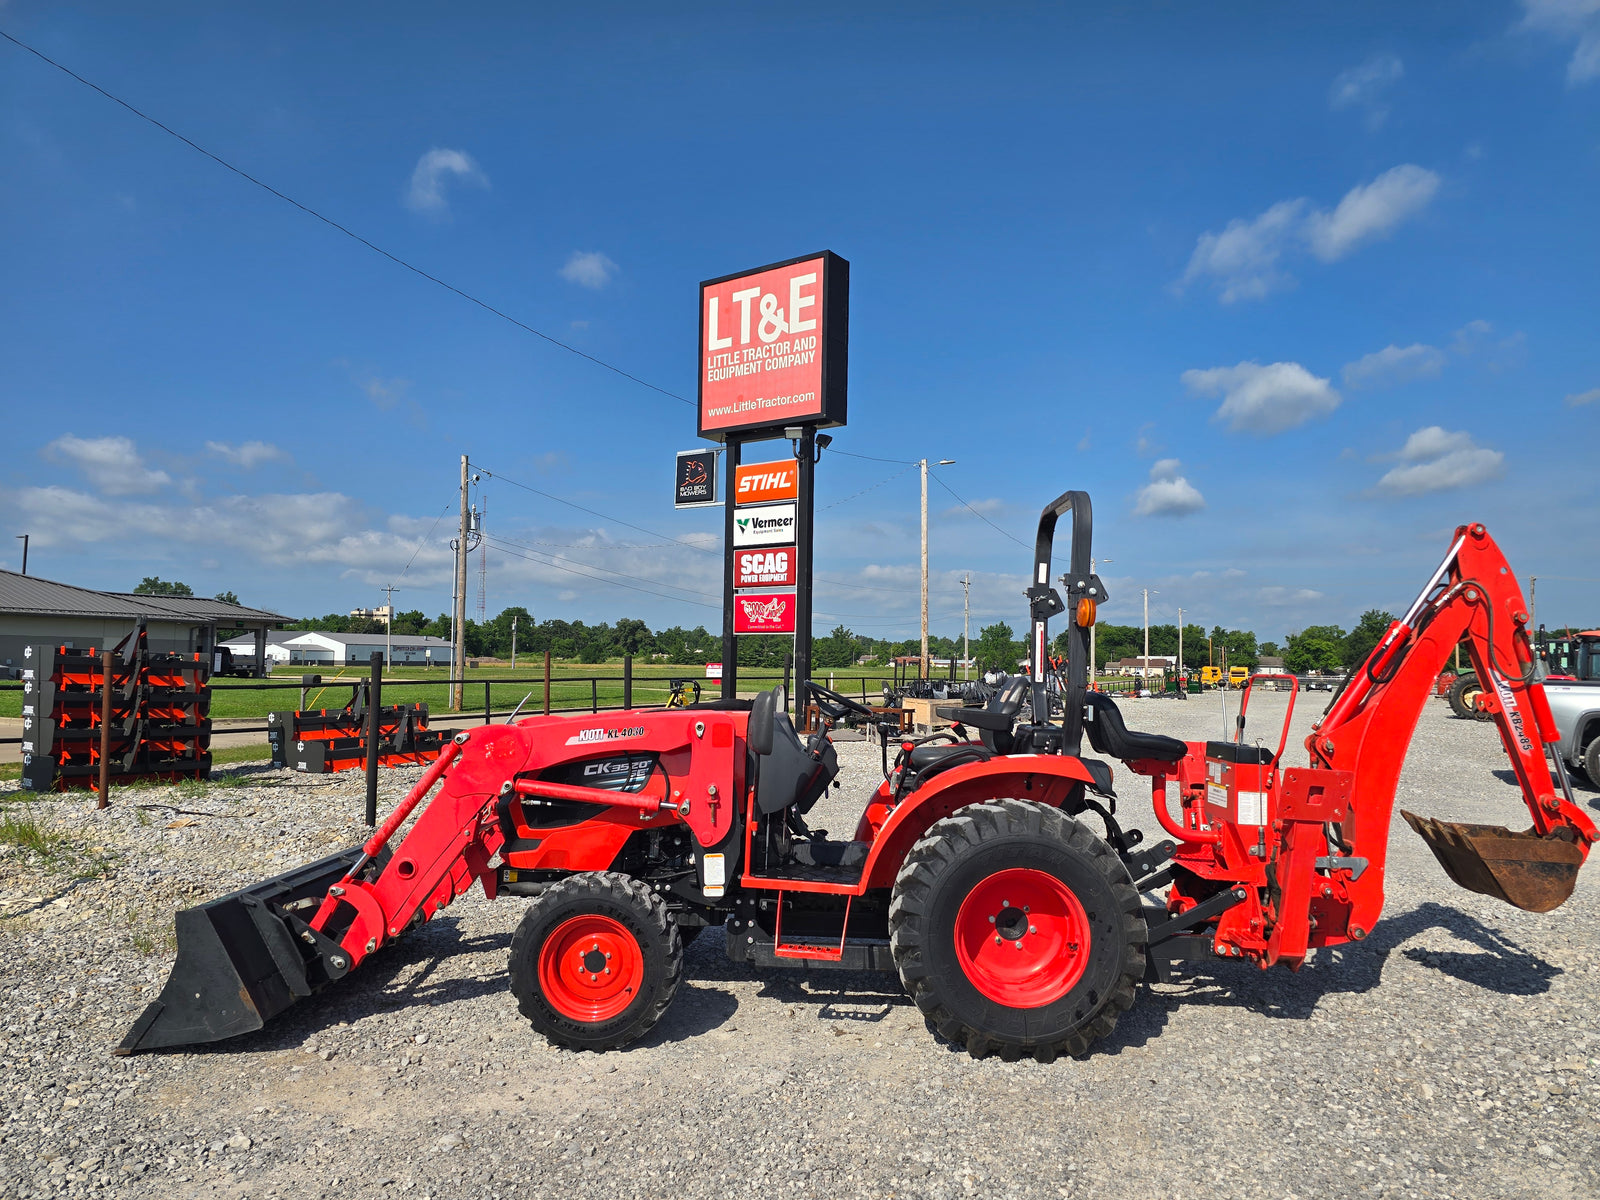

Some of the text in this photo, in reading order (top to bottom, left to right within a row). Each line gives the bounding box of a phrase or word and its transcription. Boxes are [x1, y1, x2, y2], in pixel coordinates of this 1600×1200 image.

[708, 272, 817, 351] LT&E
[707, 335, 817, 370] LITTLE TRACTOR AND
[707, 350, 816, 383] EQUIPMENT COMPANY
[708, 391, 815, 417] www.LittleTractor.com
[738, 471, 792, 493] STIHL
[751, 516, 794, 529] Vermeer
[740, 551, 788, 575] SCAG
[740, 573, 788, 583] POWER EQUIPMENT
[578, 728, 605, 742] KIOTI
